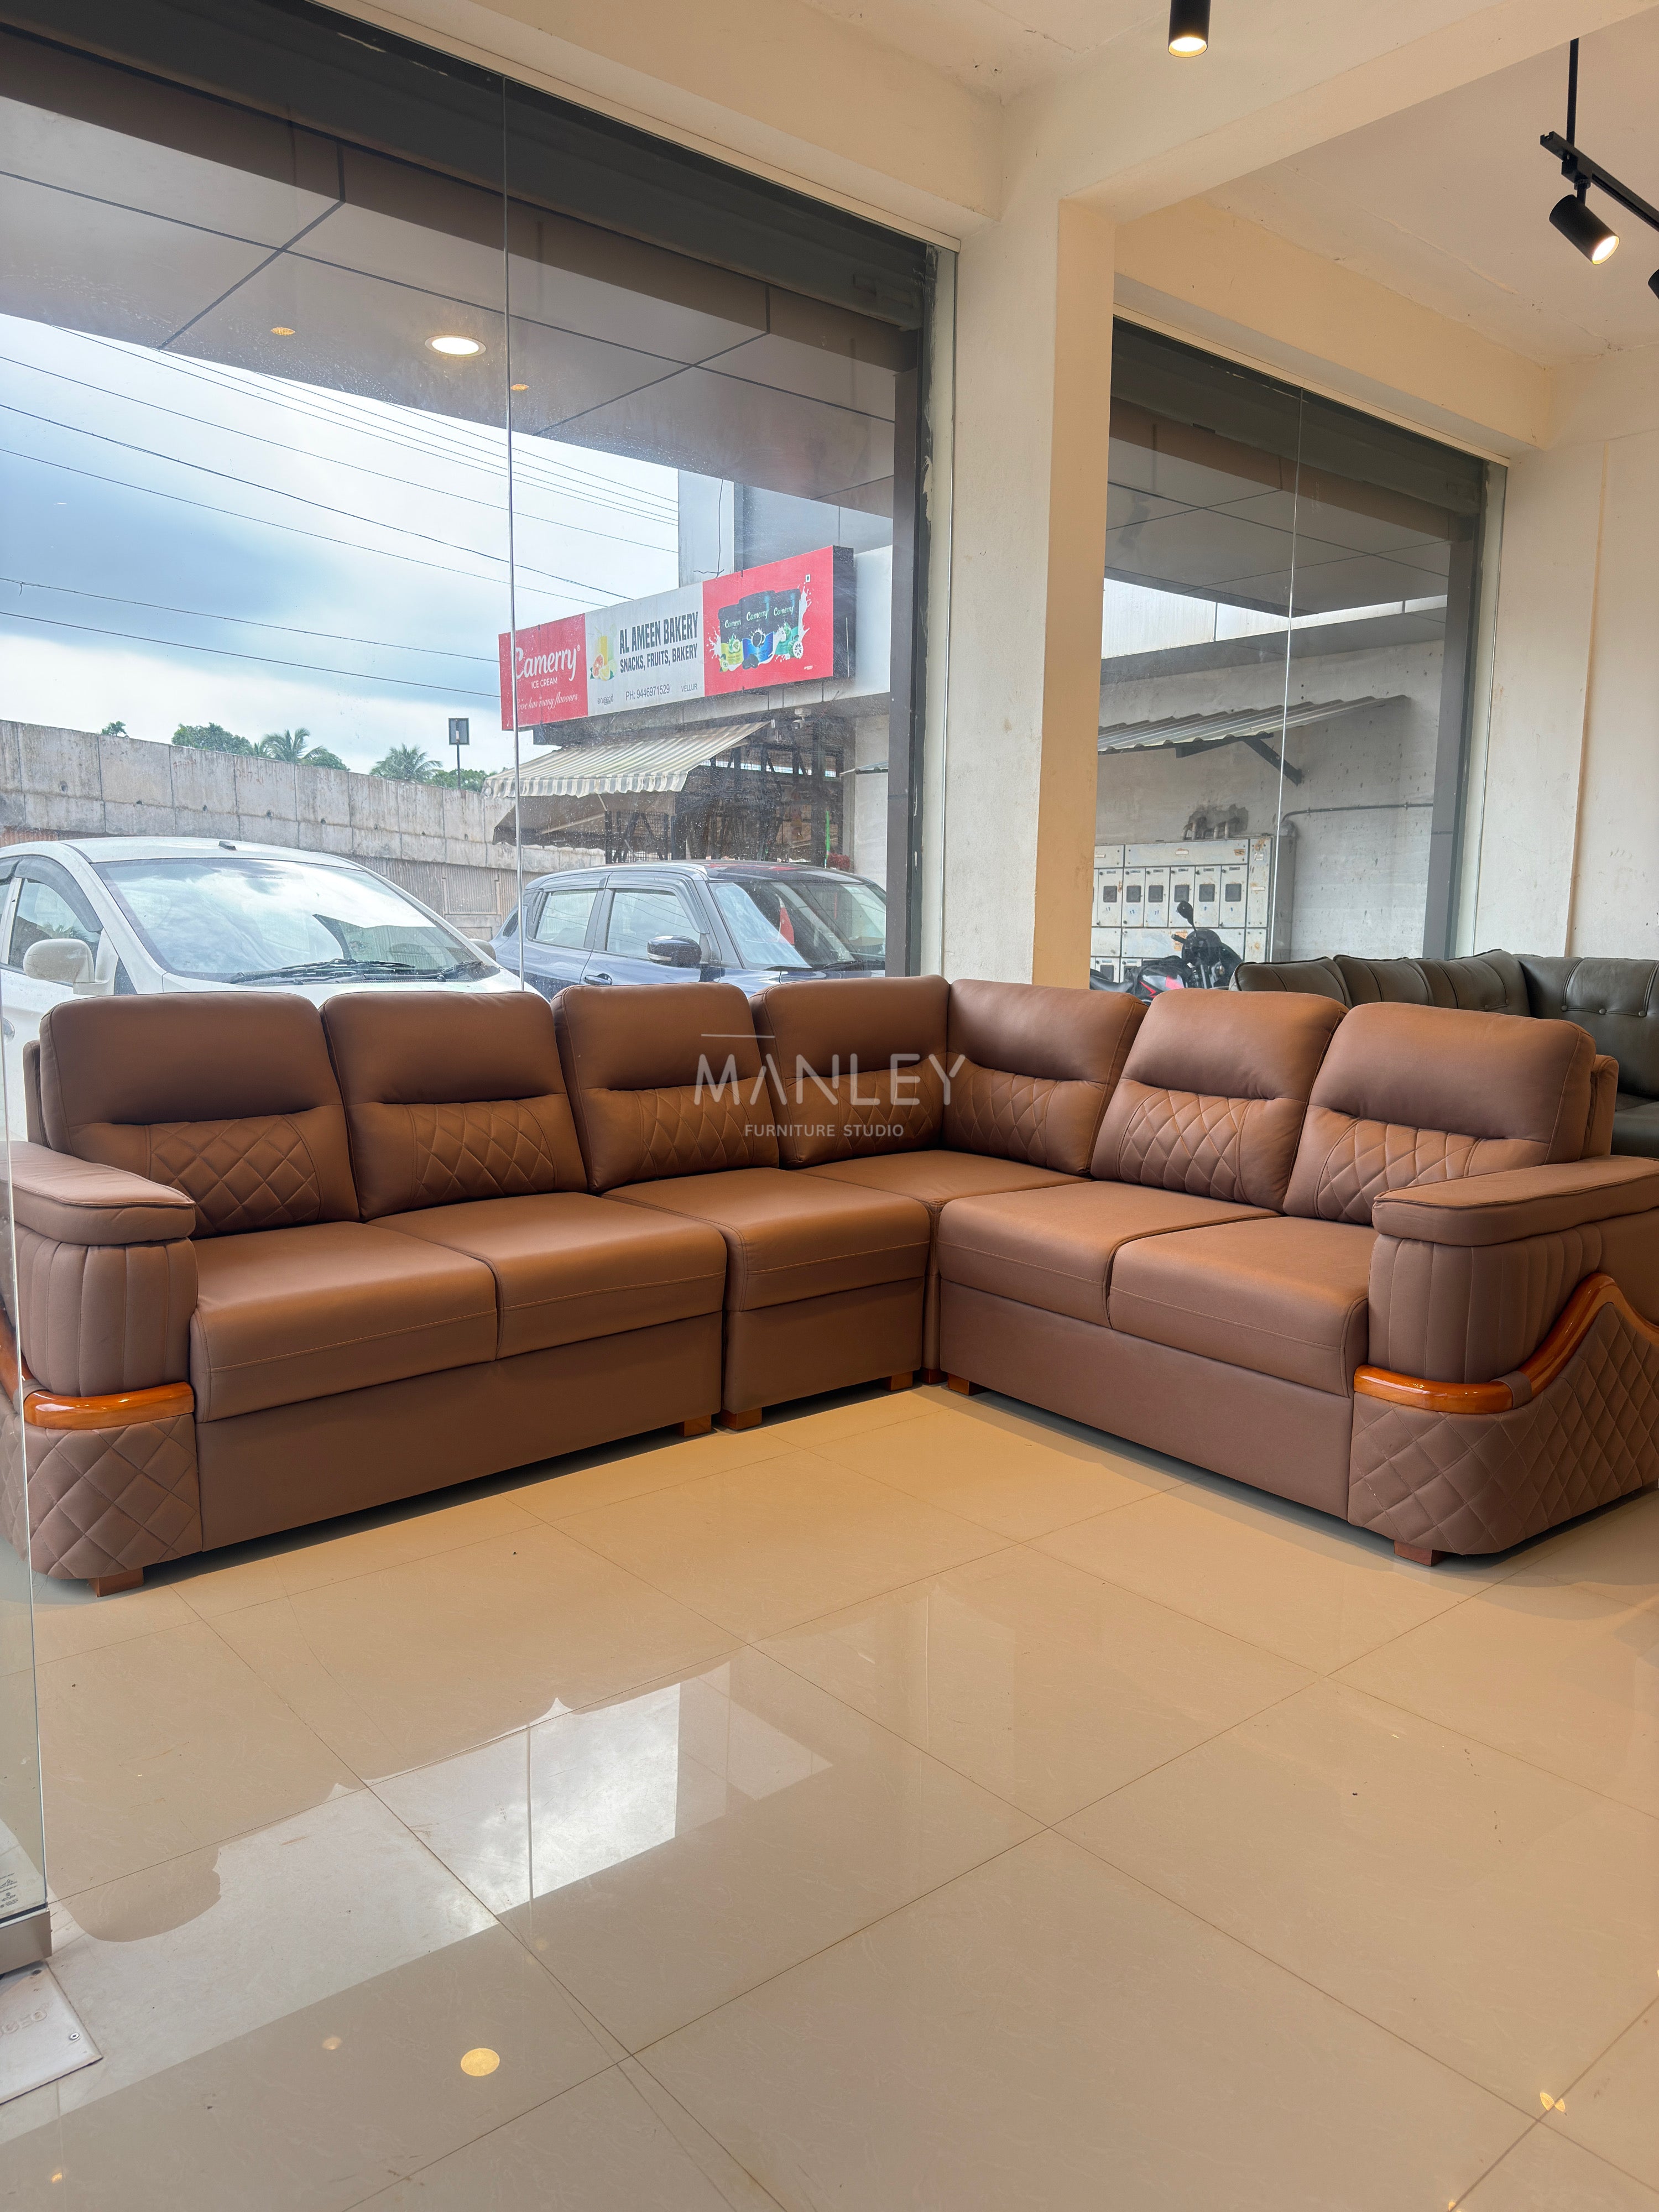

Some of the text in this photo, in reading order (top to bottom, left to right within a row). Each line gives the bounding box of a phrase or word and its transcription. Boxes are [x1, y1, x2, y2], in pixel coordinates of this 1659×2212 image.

[620, 611, 698, 655] AL AMEEN BAKERY
[620, 643, 697, 673] SNACKS, FRUITS, BAKERY
[531, 676, 558, 689] ICE CREAM
[681, 684, 698, 692] VELLUR
[528, 697, 538, 709] has
[539, 698, 554, 710] many
[552, 691, 578, 709] flavours
[625, 684, 670, 701] PH: 9446971529
